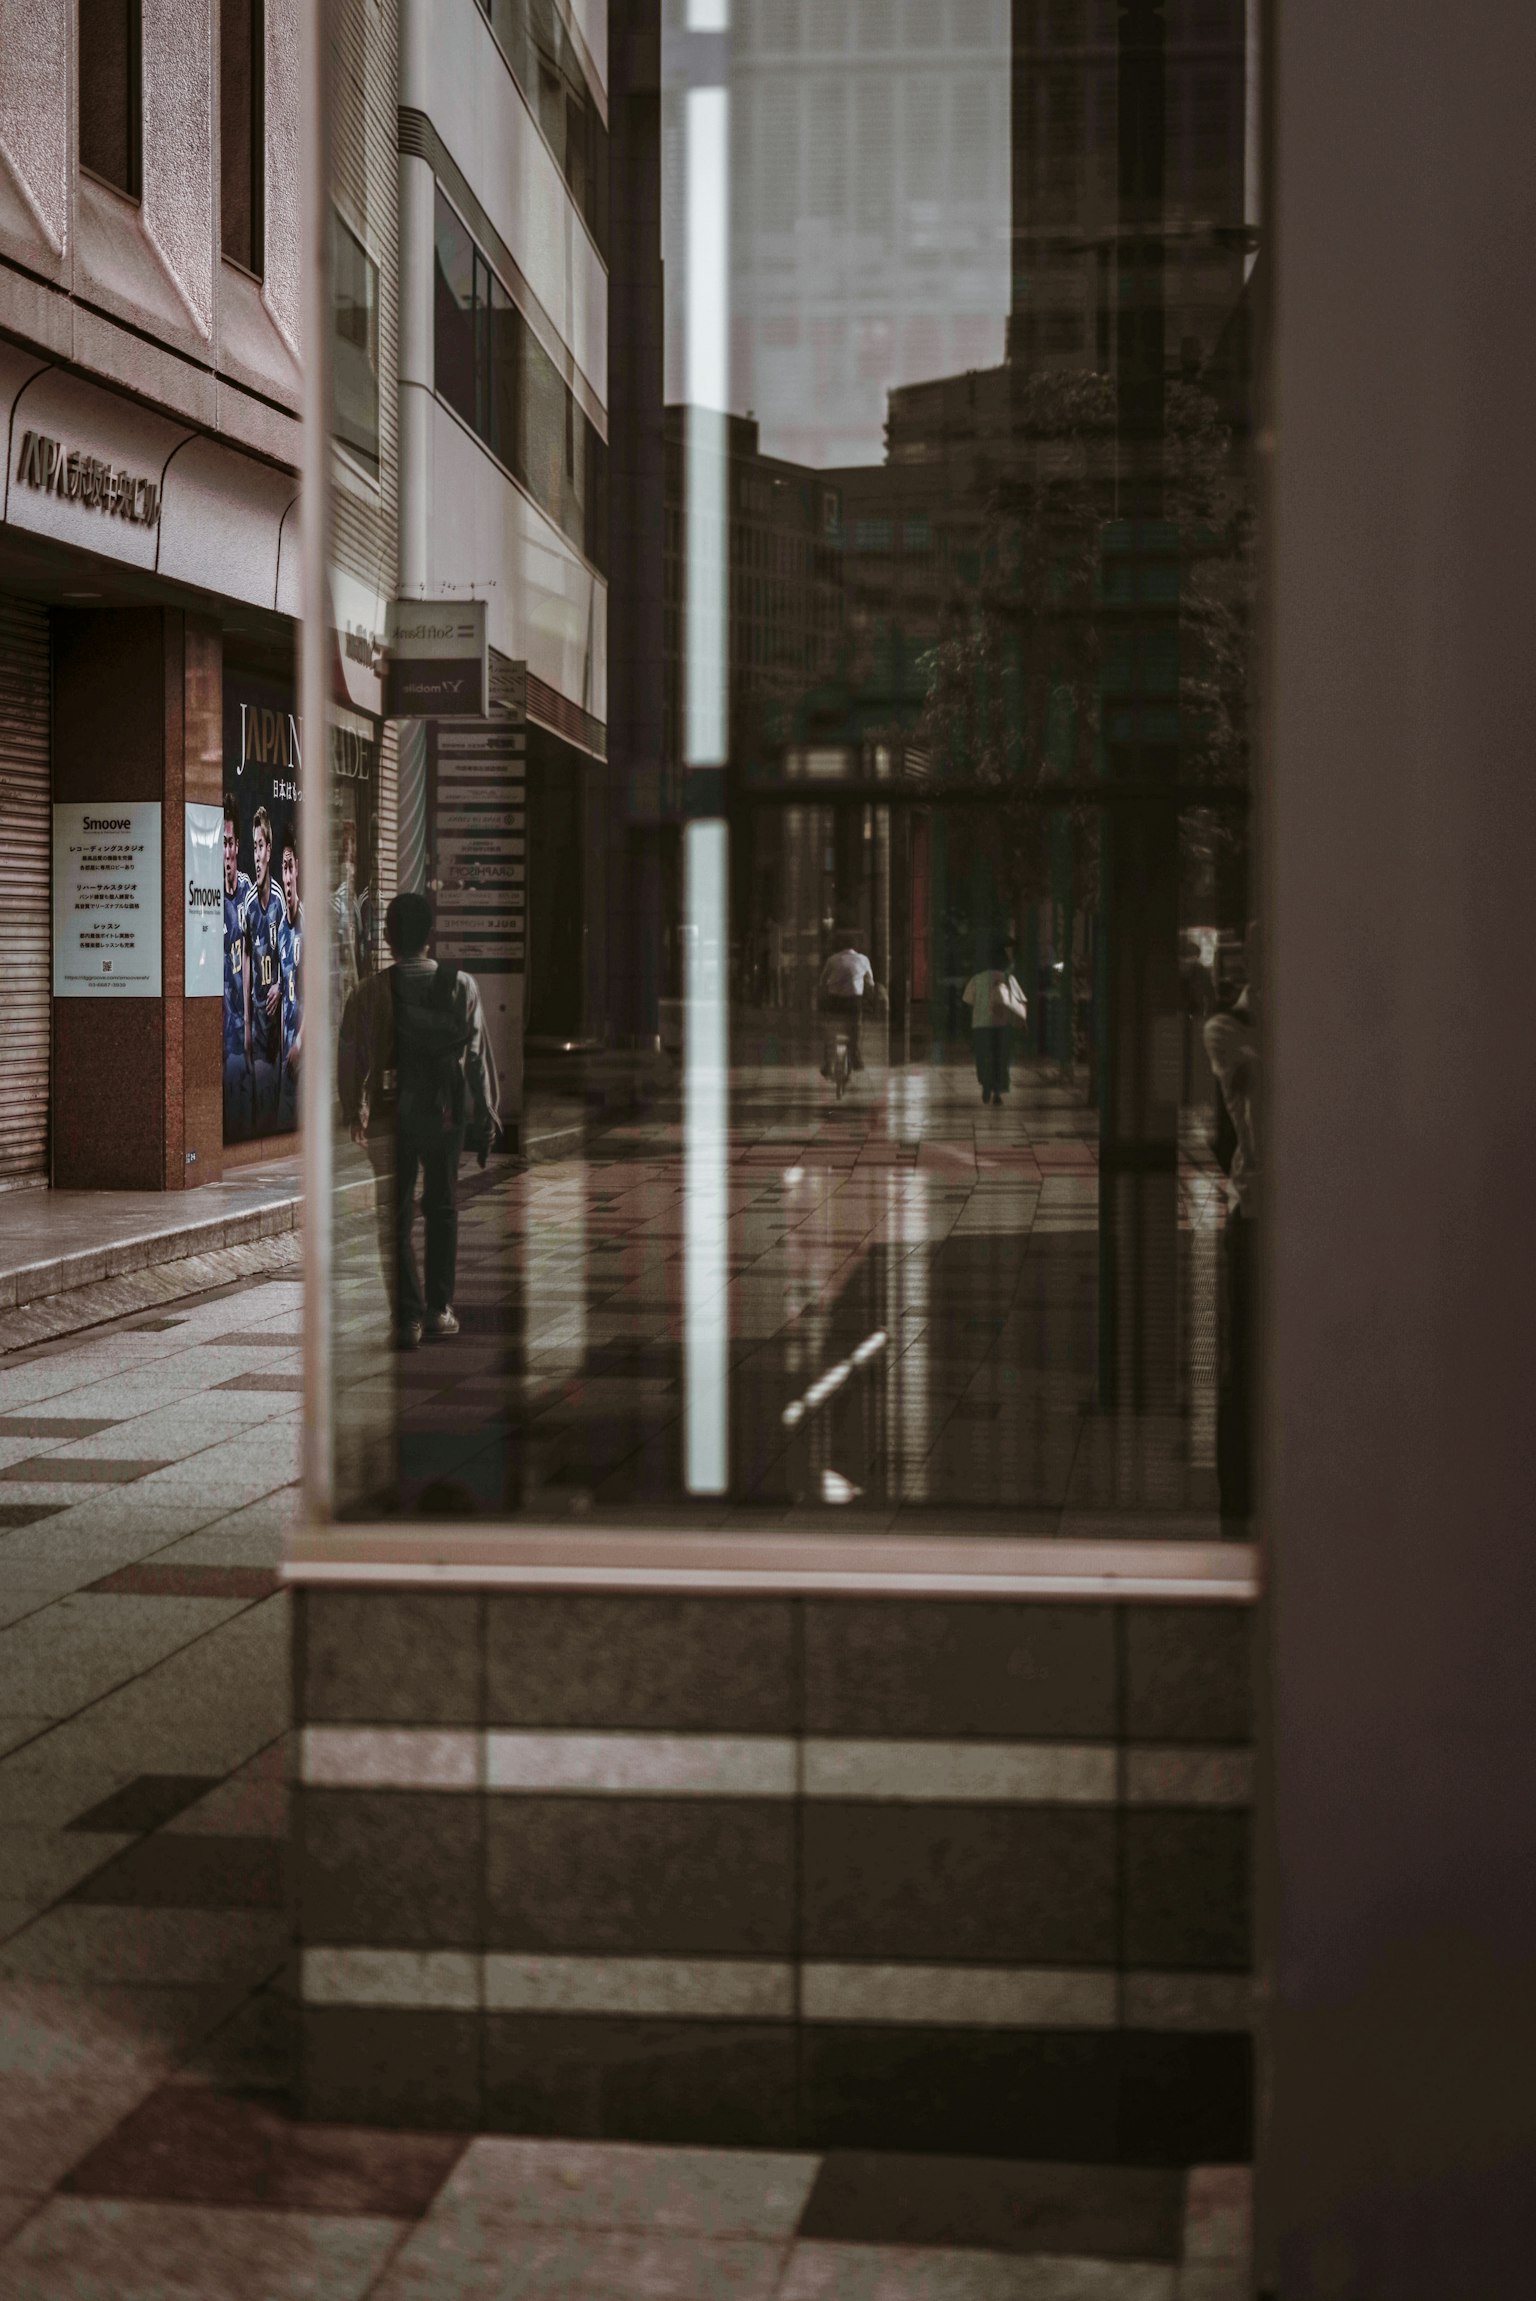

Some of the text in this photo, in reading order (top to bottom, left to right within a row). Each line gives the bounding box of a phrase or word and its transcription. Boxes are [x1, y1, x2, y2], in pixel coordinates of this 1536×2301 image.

[83, 817, 131, 830] Smoove
[189, 880, 221, 907] Smoove
[261, 954, 272, 986] 10
